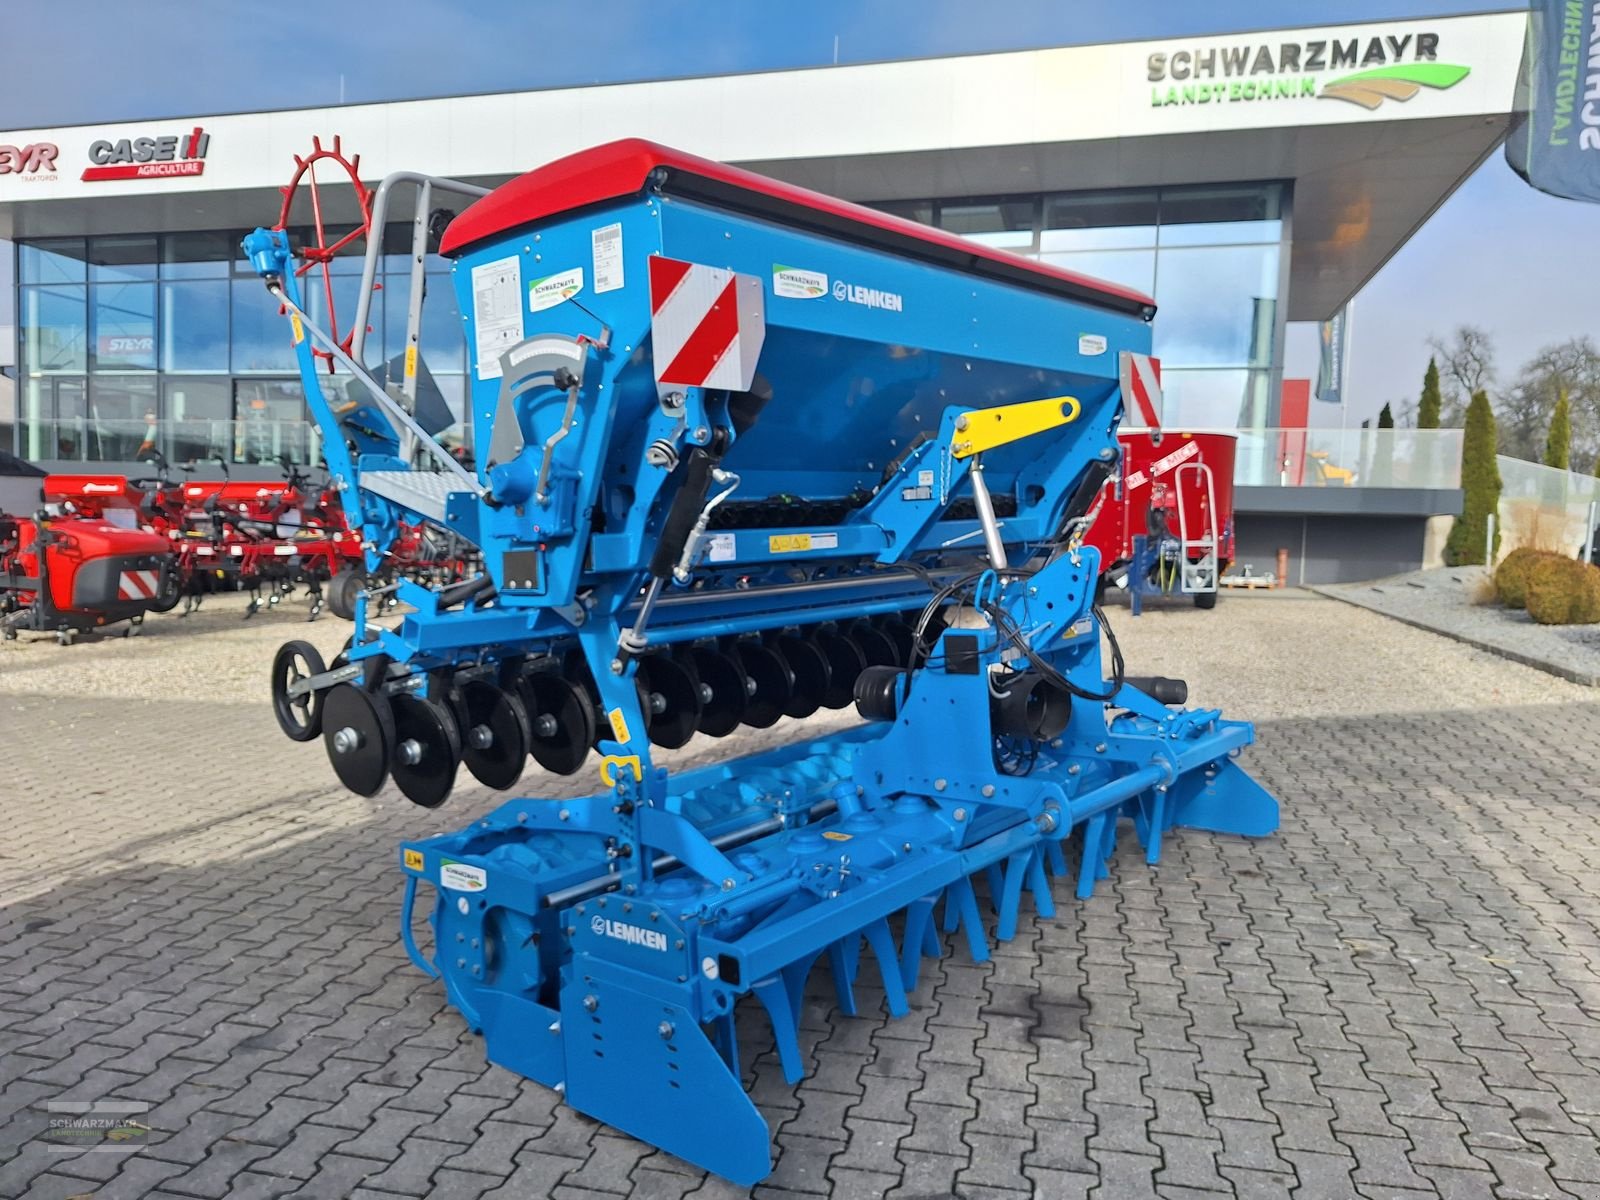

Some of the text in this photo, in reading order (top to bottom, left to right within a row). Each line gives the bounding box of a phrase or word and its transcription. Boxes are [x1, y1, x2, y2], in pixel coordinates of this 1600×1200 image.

[1147, 33, 1439, 82] SCHWARZMAYR
[1151, 76, 1316, 107] LANDTECHNIK
[88, 136, 178, 165] CASE
[137, 162, 199, 176] AGRICULTURE
[847, 284, 902, 312] LEMKEN
[109, 338, 153, 351] STEYR
[605, 919, 667, 952] LEMKEN
